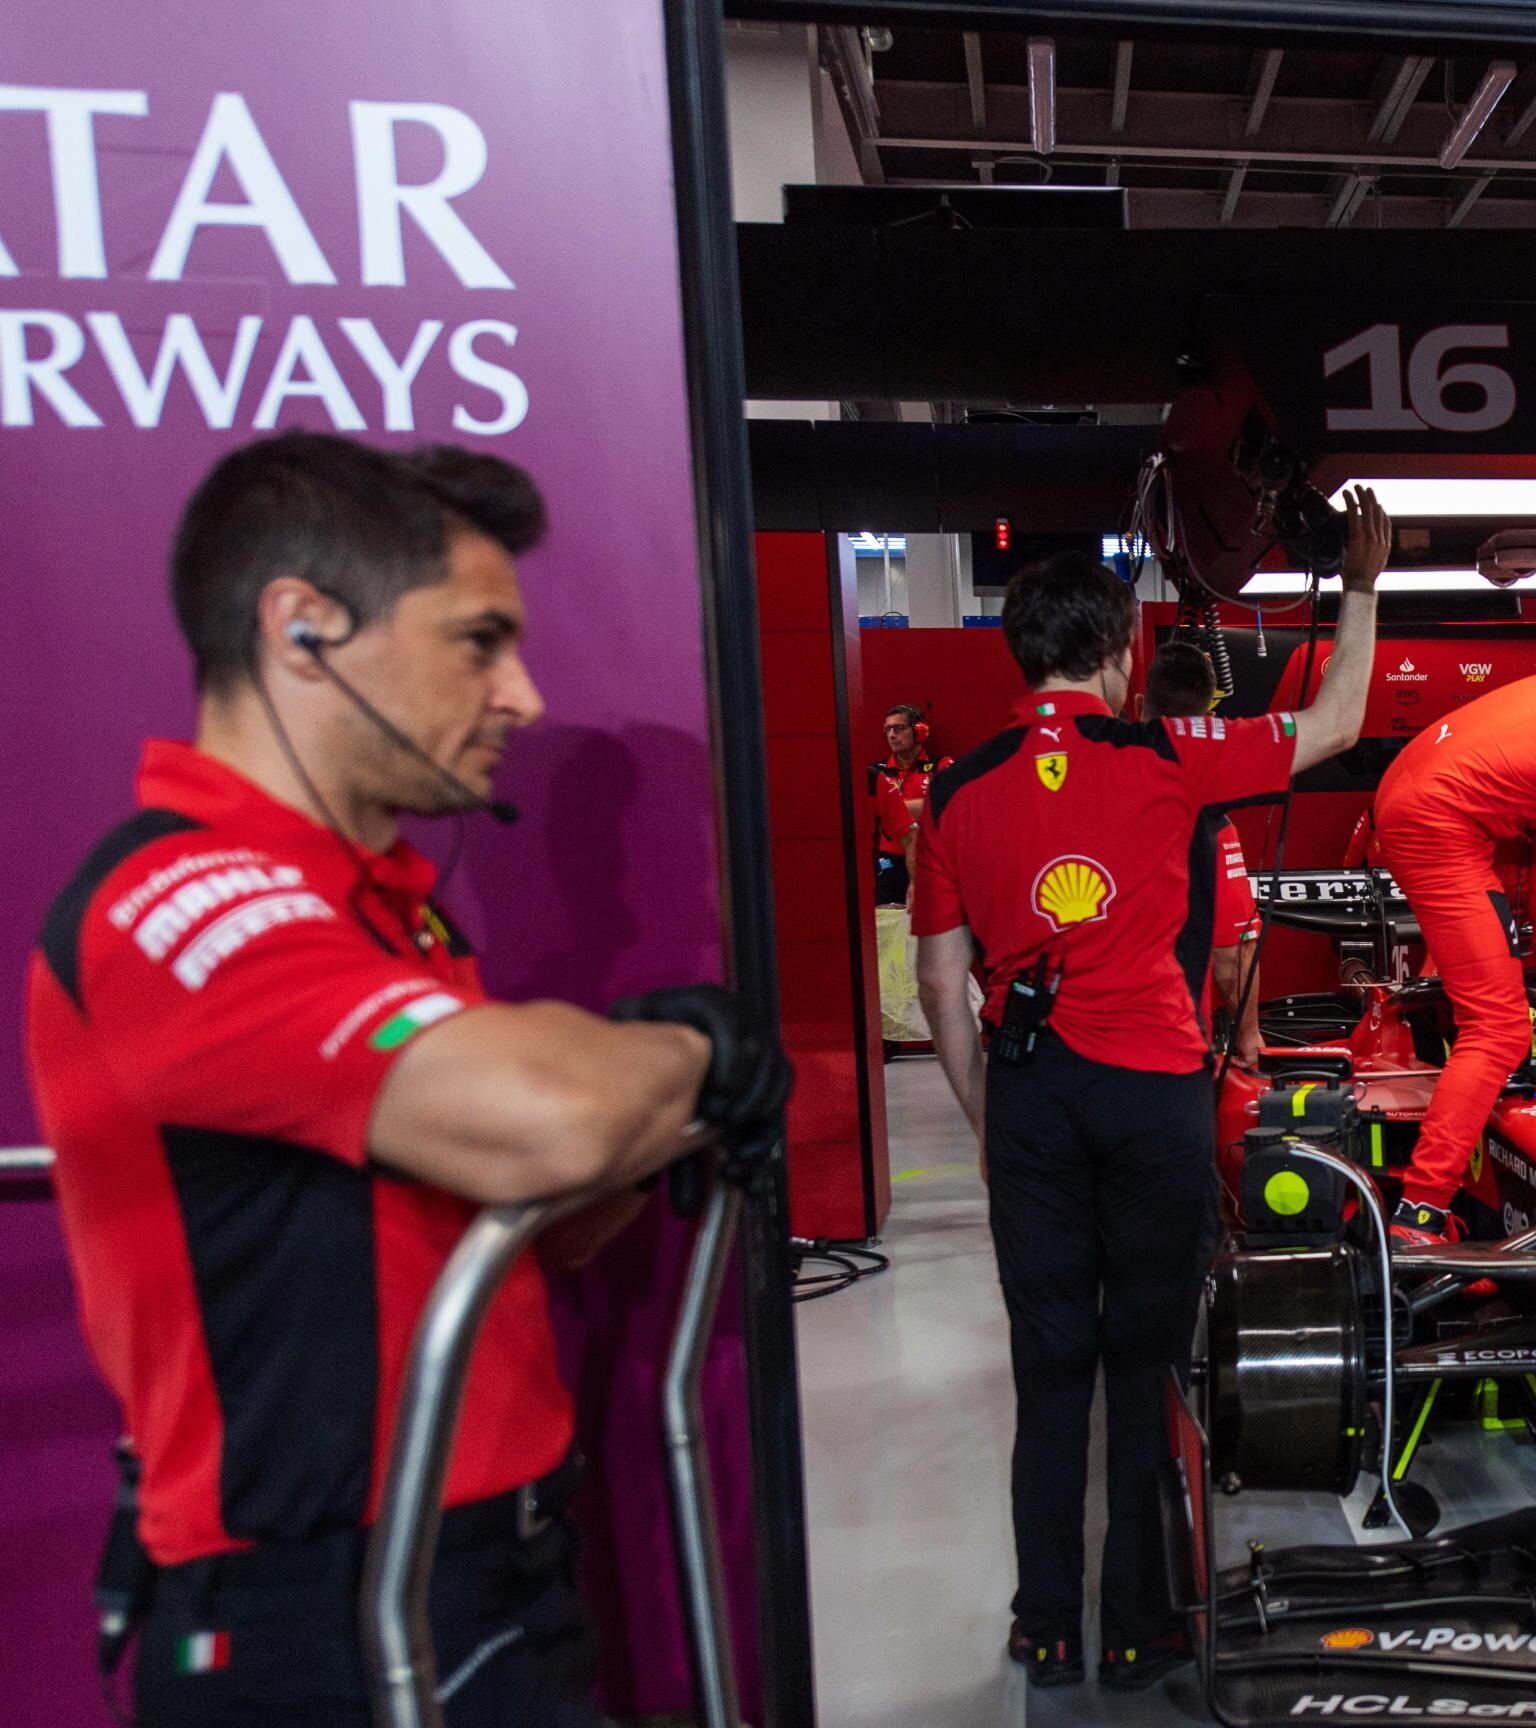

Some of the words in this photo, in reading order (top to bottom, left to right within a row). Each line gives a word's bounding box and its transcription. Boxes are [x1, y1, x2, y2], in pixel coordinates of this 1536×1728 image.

[0, 85, 516, 290] TAR
[1323, 323, 1516, 433] 16
[1386, 673, 1428, 682] Santander
[1459, 663, 1492, 675] VGW
[1466, 674, 1486, 682] PLAY
[1488, 1138, 1527, 1180] RICHARD
